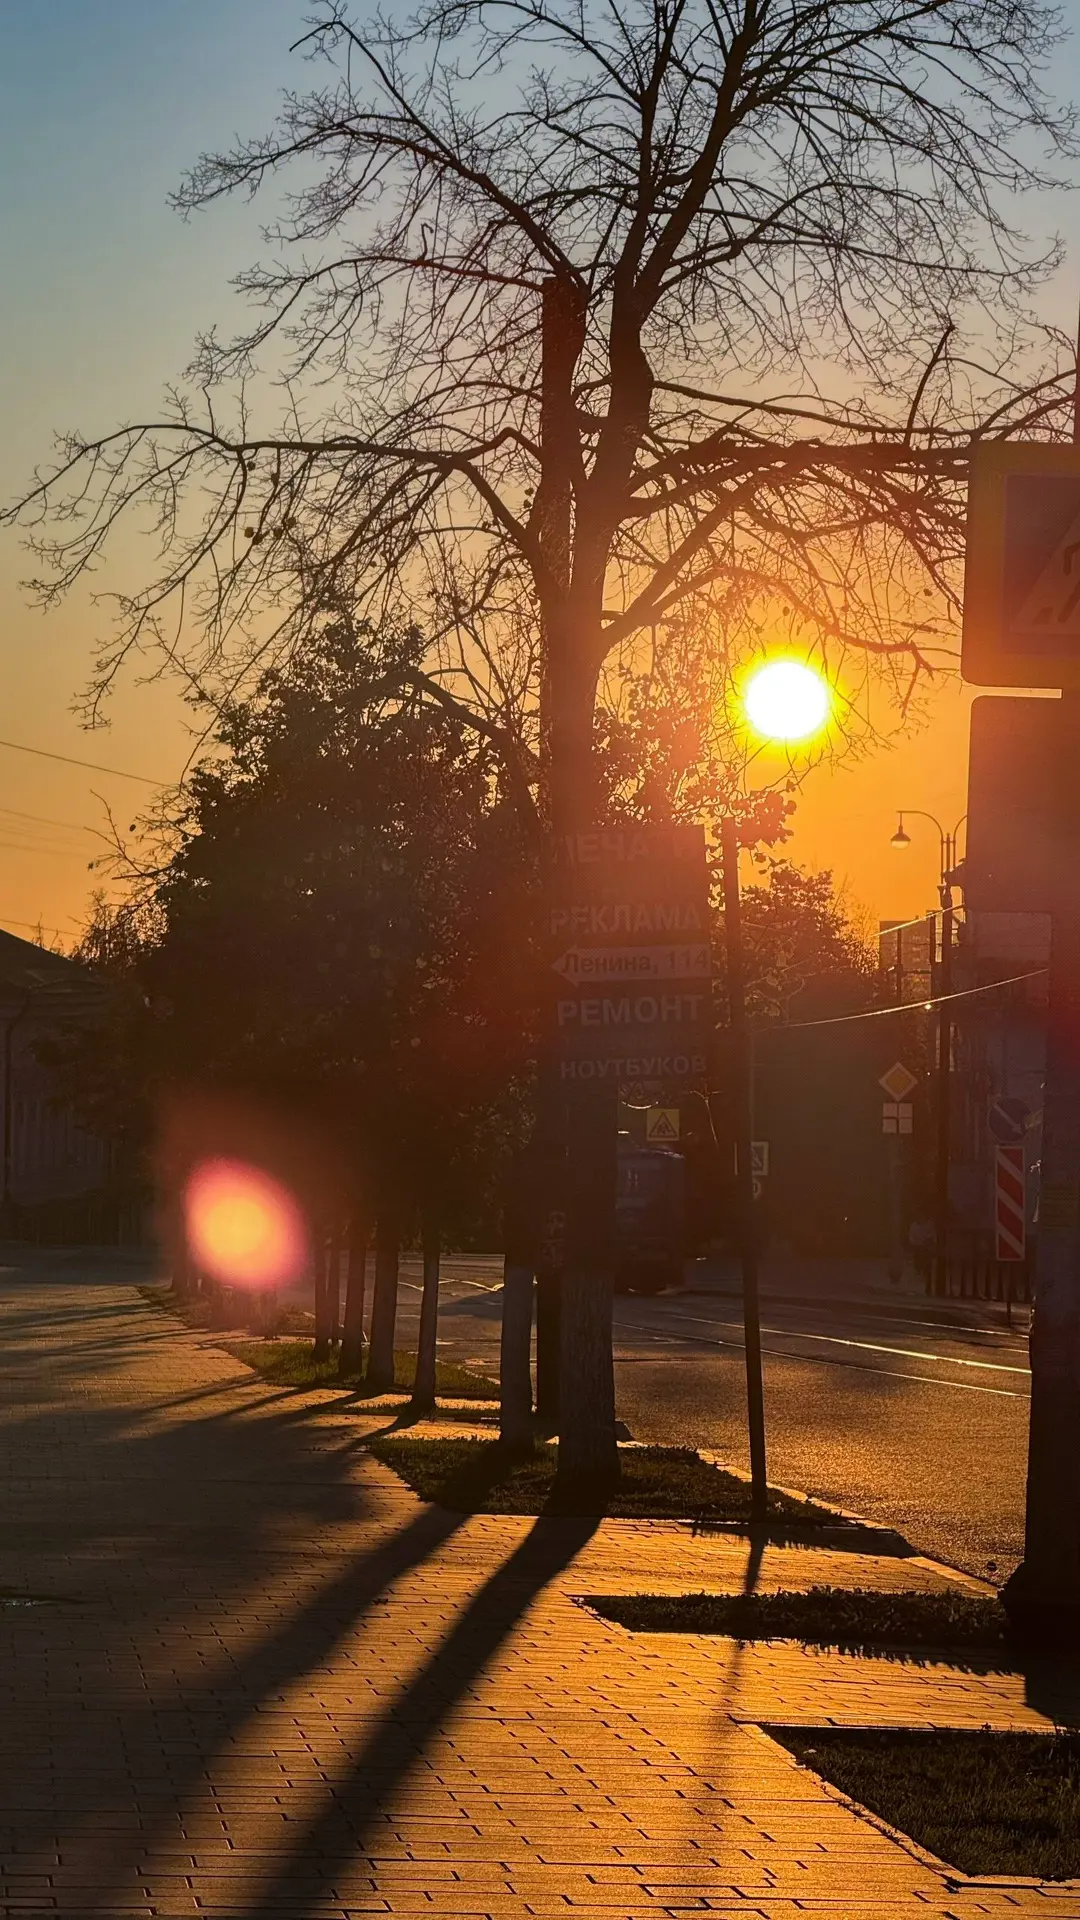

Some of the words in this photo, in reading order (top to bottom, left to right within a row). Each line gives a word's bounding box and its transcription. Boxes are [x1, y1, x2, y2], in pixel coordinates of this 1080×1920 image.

[550, 901, 702, 934] РЕКЛАМА
[562, 953, 660, 975] Ленина,
[667, 950, 709, 971] 114
[557, 994, 704, 1026] РЕМОНТ
[560, 1055, 708, 1080] НОУТБУКОВ
